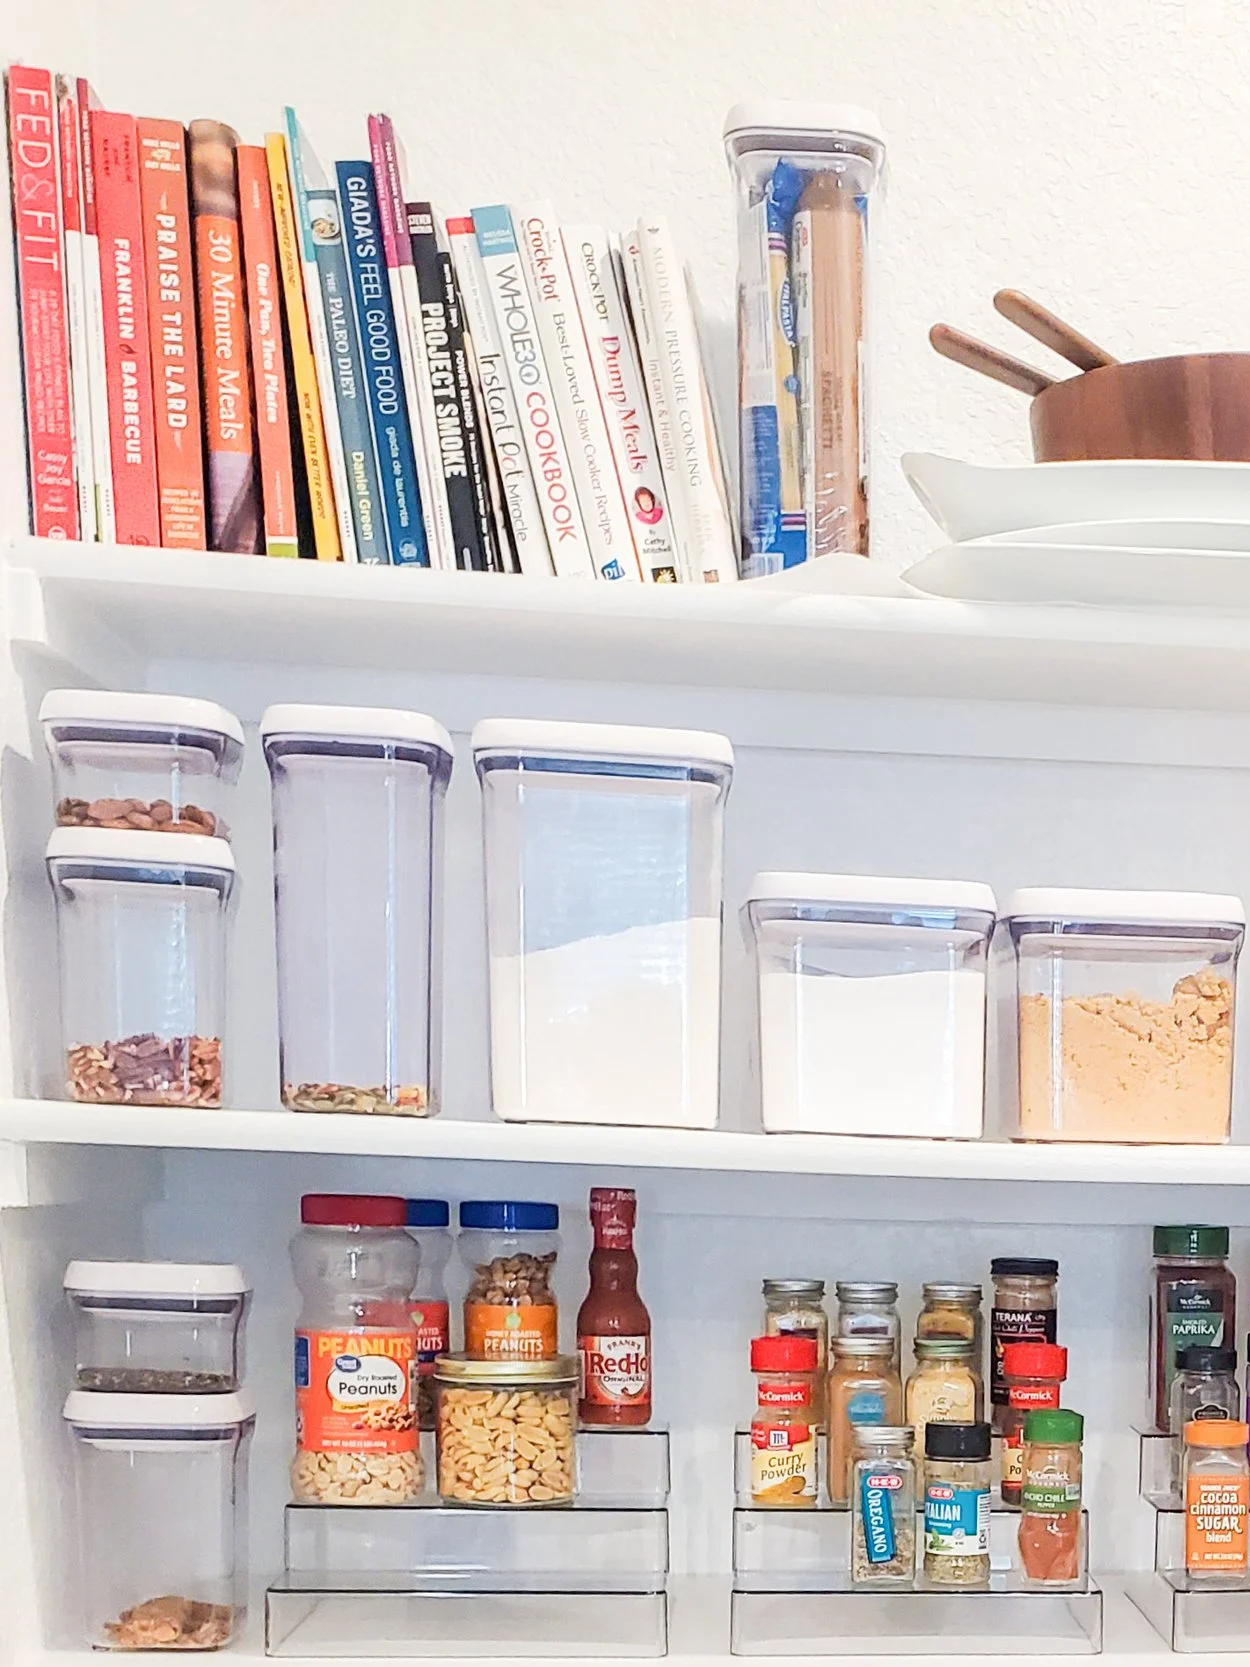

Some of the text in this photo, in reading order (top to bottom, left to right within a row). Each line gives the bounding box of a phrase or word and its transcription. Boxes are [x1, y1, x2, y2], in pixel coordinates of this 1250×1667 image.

[16, 87, 51, 169] FED
[22, 209, 59, 272] FIT
[346, 175, 377, 259] GIADA'S
[358, 263, 383, 306] FEEL
[156, 213, 188, 430] PRAISE THE LARD
[208, 229, 244, 440] 30 Minute Meals
[329, 297, 350, 354] PALEO
[366, 309, 392, 361] GOOD
[114, 238, 142, 465] FRANKLIN BARBECUE
[421, 302, 457, 400] PROJECT
[336, 356, 357, 399] DIET
[374, 365, 399, 415] FOOD
[496, 263, 541, 386] WHOLE30
[526, 391, 578, 542] COOKBOOK
[575, 408, 592, 443] Slow
[602, 336, 649, 472] Dump Meals
[436, 401, 468, 479] SMOKE
[480, 352, 528, 543] Instant Miracle
[678, 408, 703, 488] COOKING
[583, 444, 602, 492] Cooker
[351, 451, 374, 542] Daniel Green
[318, 1337, 412, 1359] PEANUTS
[484, 1339, 543, 1353] PEANUTS
[1172, 1324, 1215, 1335] PAPRIKA
[339, 1382, 398, 1395] Peanuts
[758, 1391, 804, 1402] McCormick
[761, 1462, 807, 1480] Powder
[768, 1452, 804, 1468] Curry
[867, 1489, 887, 1553] OREGANO
[1190, 1502, 1246, 1516] cinnamon
[1201, 1492, 1238, 1504] cocoa
[1196, 1516, 1243, 1533] SUGAR
[1205, 1532, 1232, 1543] blend
